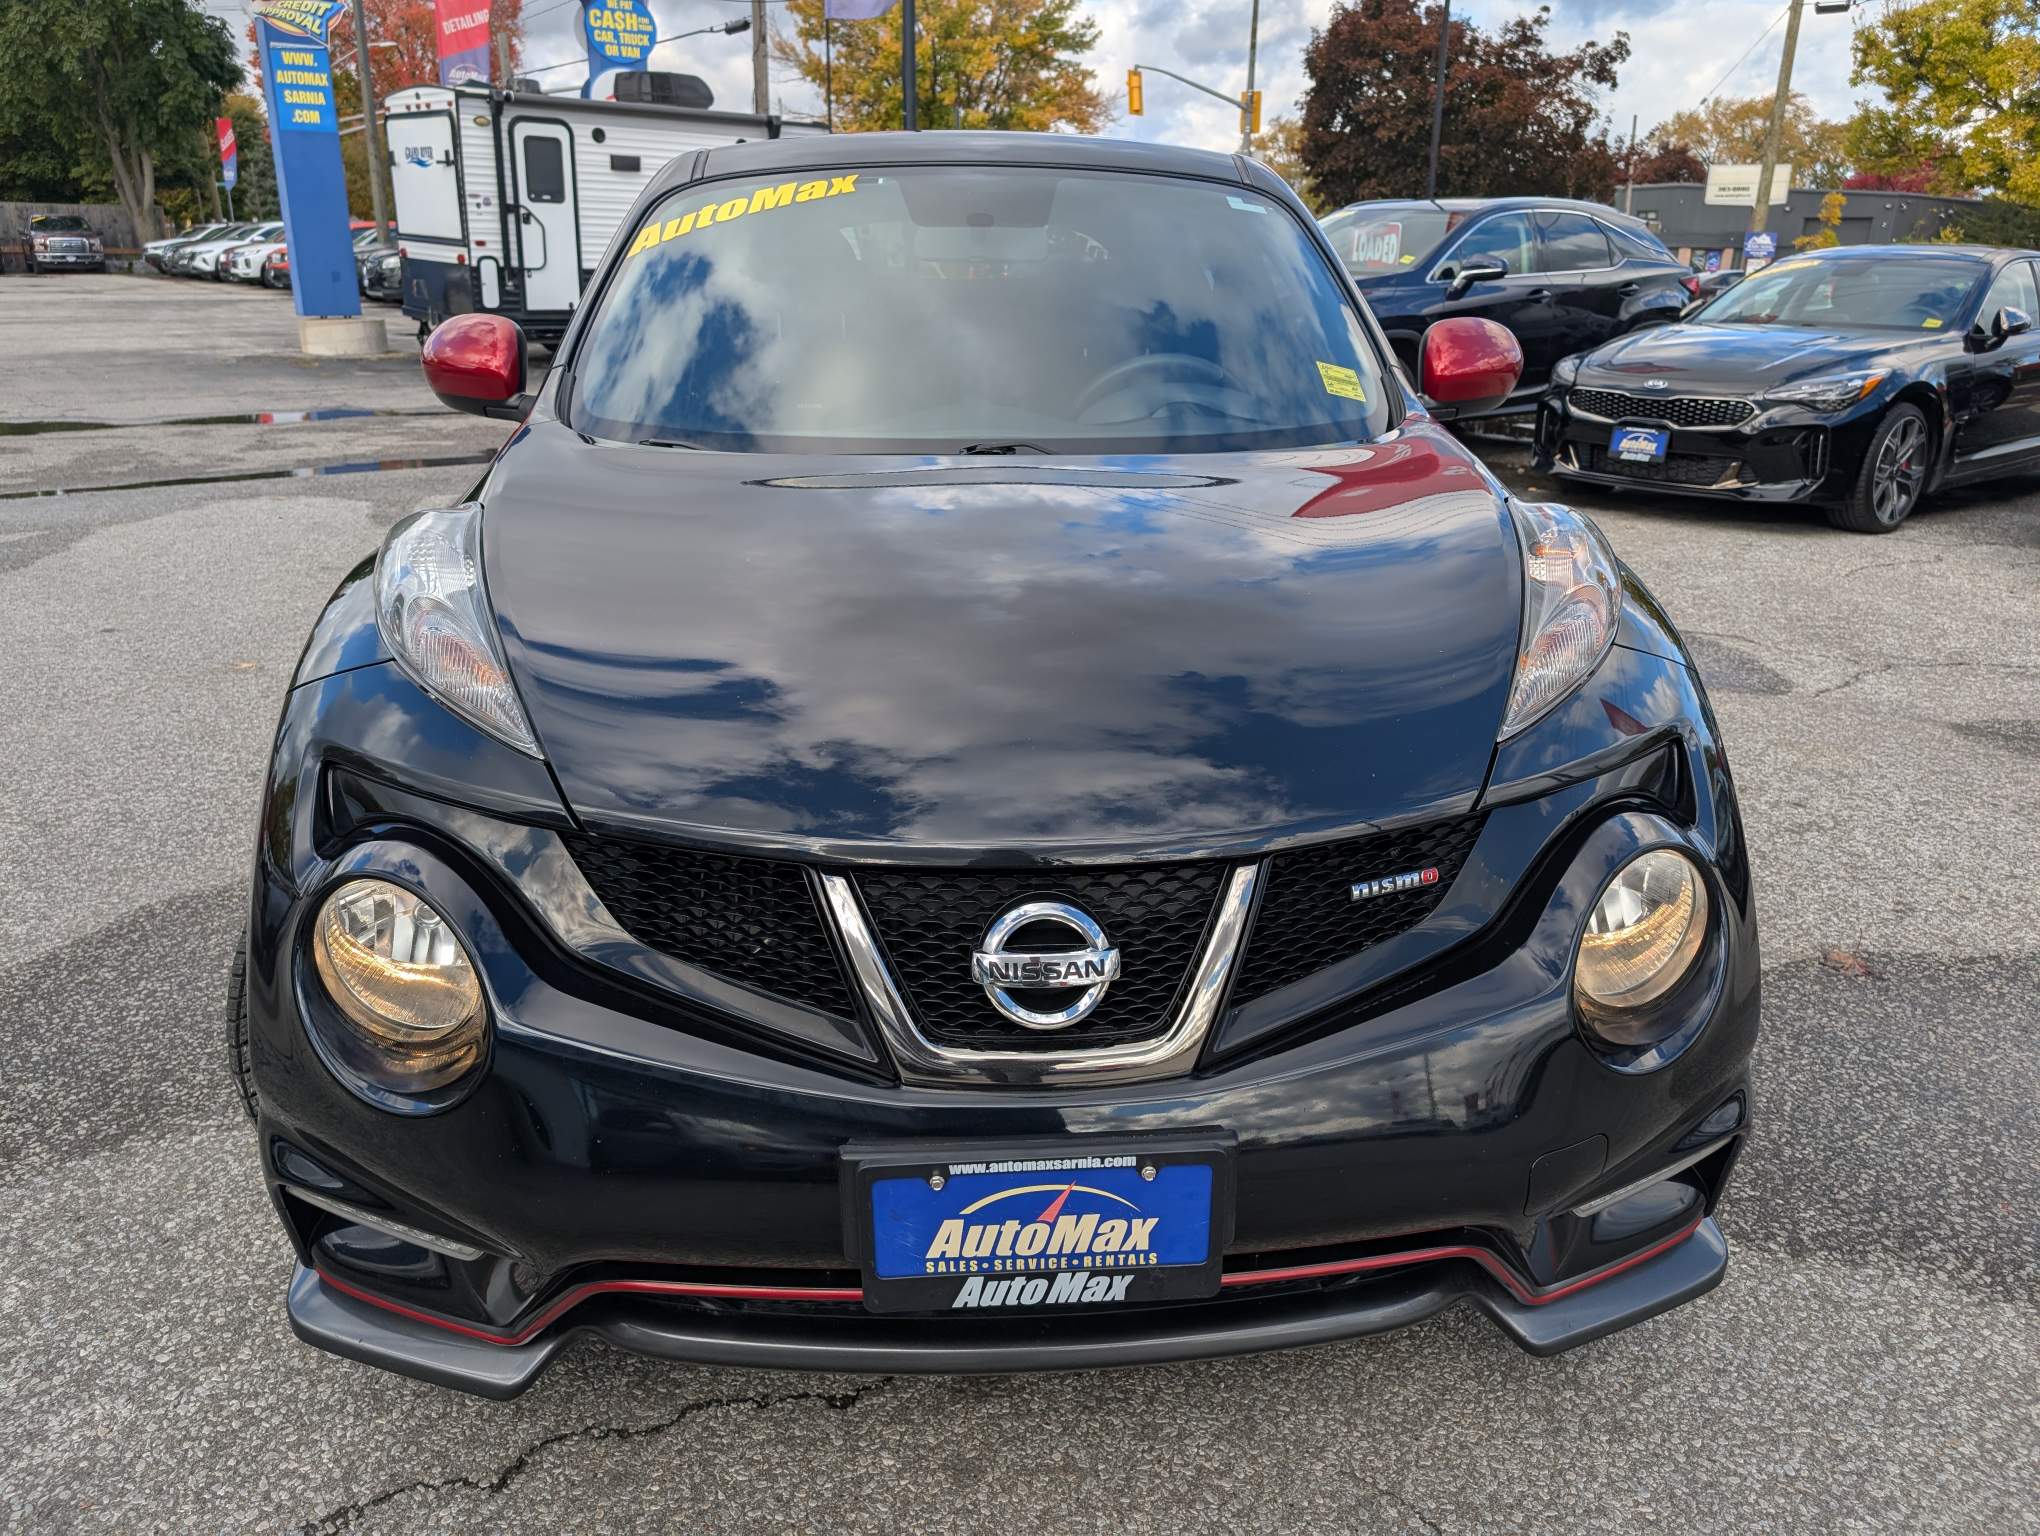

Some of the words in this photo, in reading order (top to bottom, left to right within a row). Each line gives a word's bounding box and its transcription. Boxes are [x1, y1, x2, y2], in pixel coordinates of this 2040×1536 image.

[279, 0, 332, 17] CREDIT
[260, 7, 322, 35] APPROVAL
[442, 9, 489, 34] DETAILING
[619, 32, 650, 46] TRUCK
[281, 51, 318, 67] WWW.
[605, 44, 619, 56] OR
[621, 46, 640, 58] VAN
[276, 69, 329, 87] AUTOMAX
[283, 89, 326, 105] SARNIA
[292, 108, 321, 124] .COM
[627, 174, 860, 258] AutoMax
[1352, 230, 1397, 264] LOADED
[988, 957, 1106, 982] NISSAN
[948, 1156, 1137, 1176] www.automaxsarnia.com
[926, 1212, 1160, 1259] AutoMax
